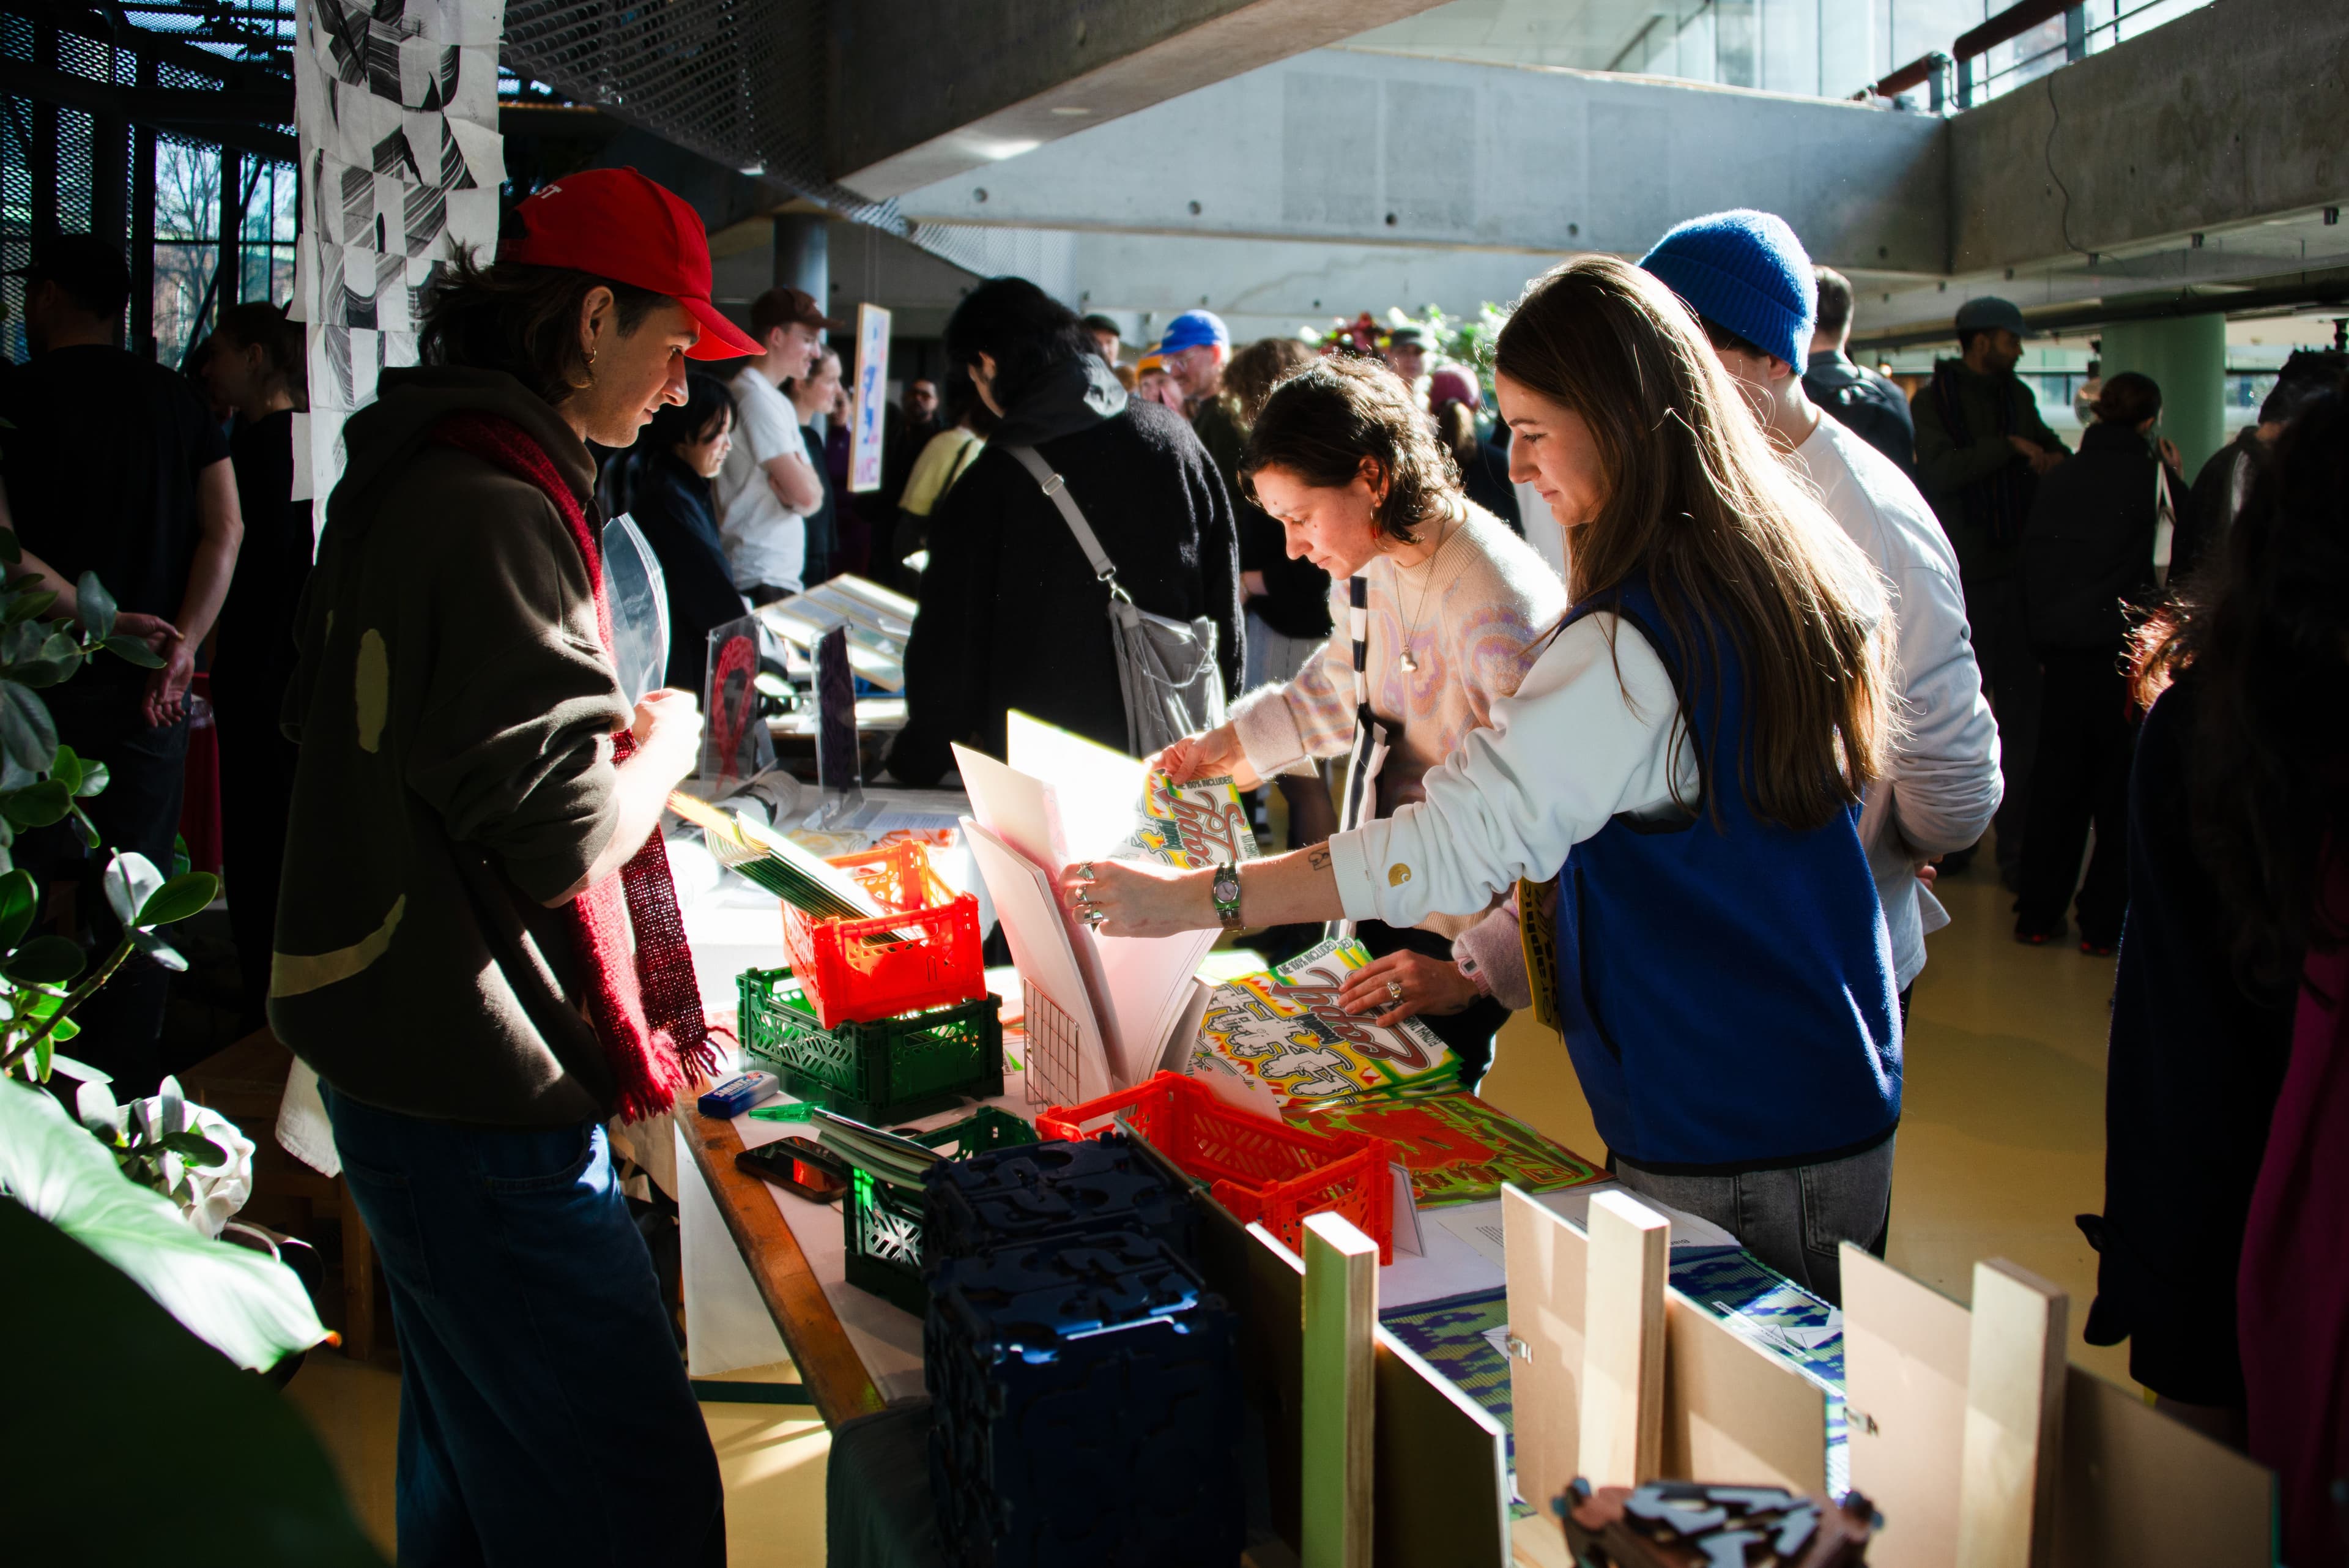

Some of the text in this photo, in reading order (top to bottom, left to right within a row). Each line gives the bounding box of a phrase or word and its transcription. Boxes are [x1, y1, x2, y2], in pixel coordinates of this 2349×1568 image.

[1186, 779, 1202, 789] 100%
[1202, 776, 1233, 787] INCLUDED
[1290, 954, 1308, 970] 100%
[1307, 940, 1338, 965] INCLUDED
